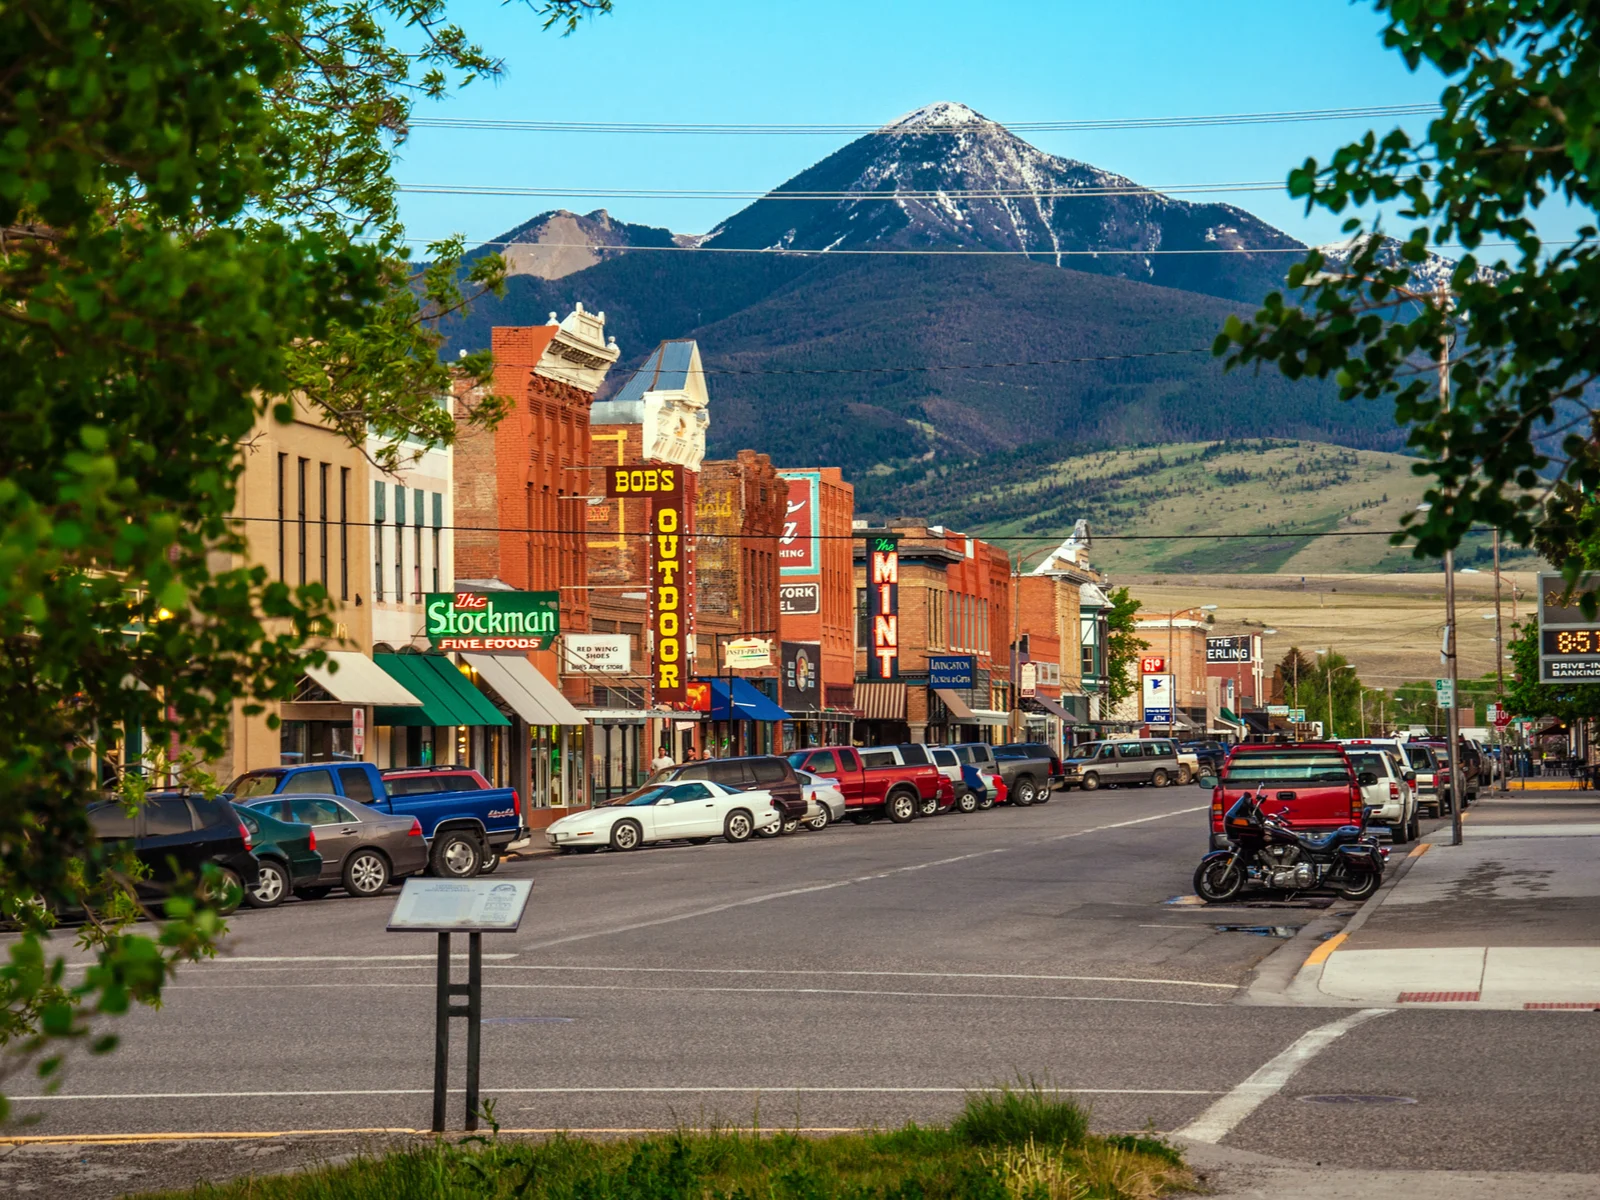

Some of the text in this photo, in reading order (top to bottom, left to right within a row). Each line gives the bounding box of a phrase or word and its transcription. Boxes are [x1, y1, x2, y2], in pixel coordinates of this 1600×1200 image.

[615, 468, 675, 492] BOB'S
[875, 539, 895, 551] The
[455, 593, 487, 608] The
[657, 508, 679, 689] OUTDOOR
[428, 600, 556, 634] Stockman
[872, 552, 898, 678] MINT
[438, 638, 541, 649] FINE FOODS
[1208, 639, 1231, 647] THE
